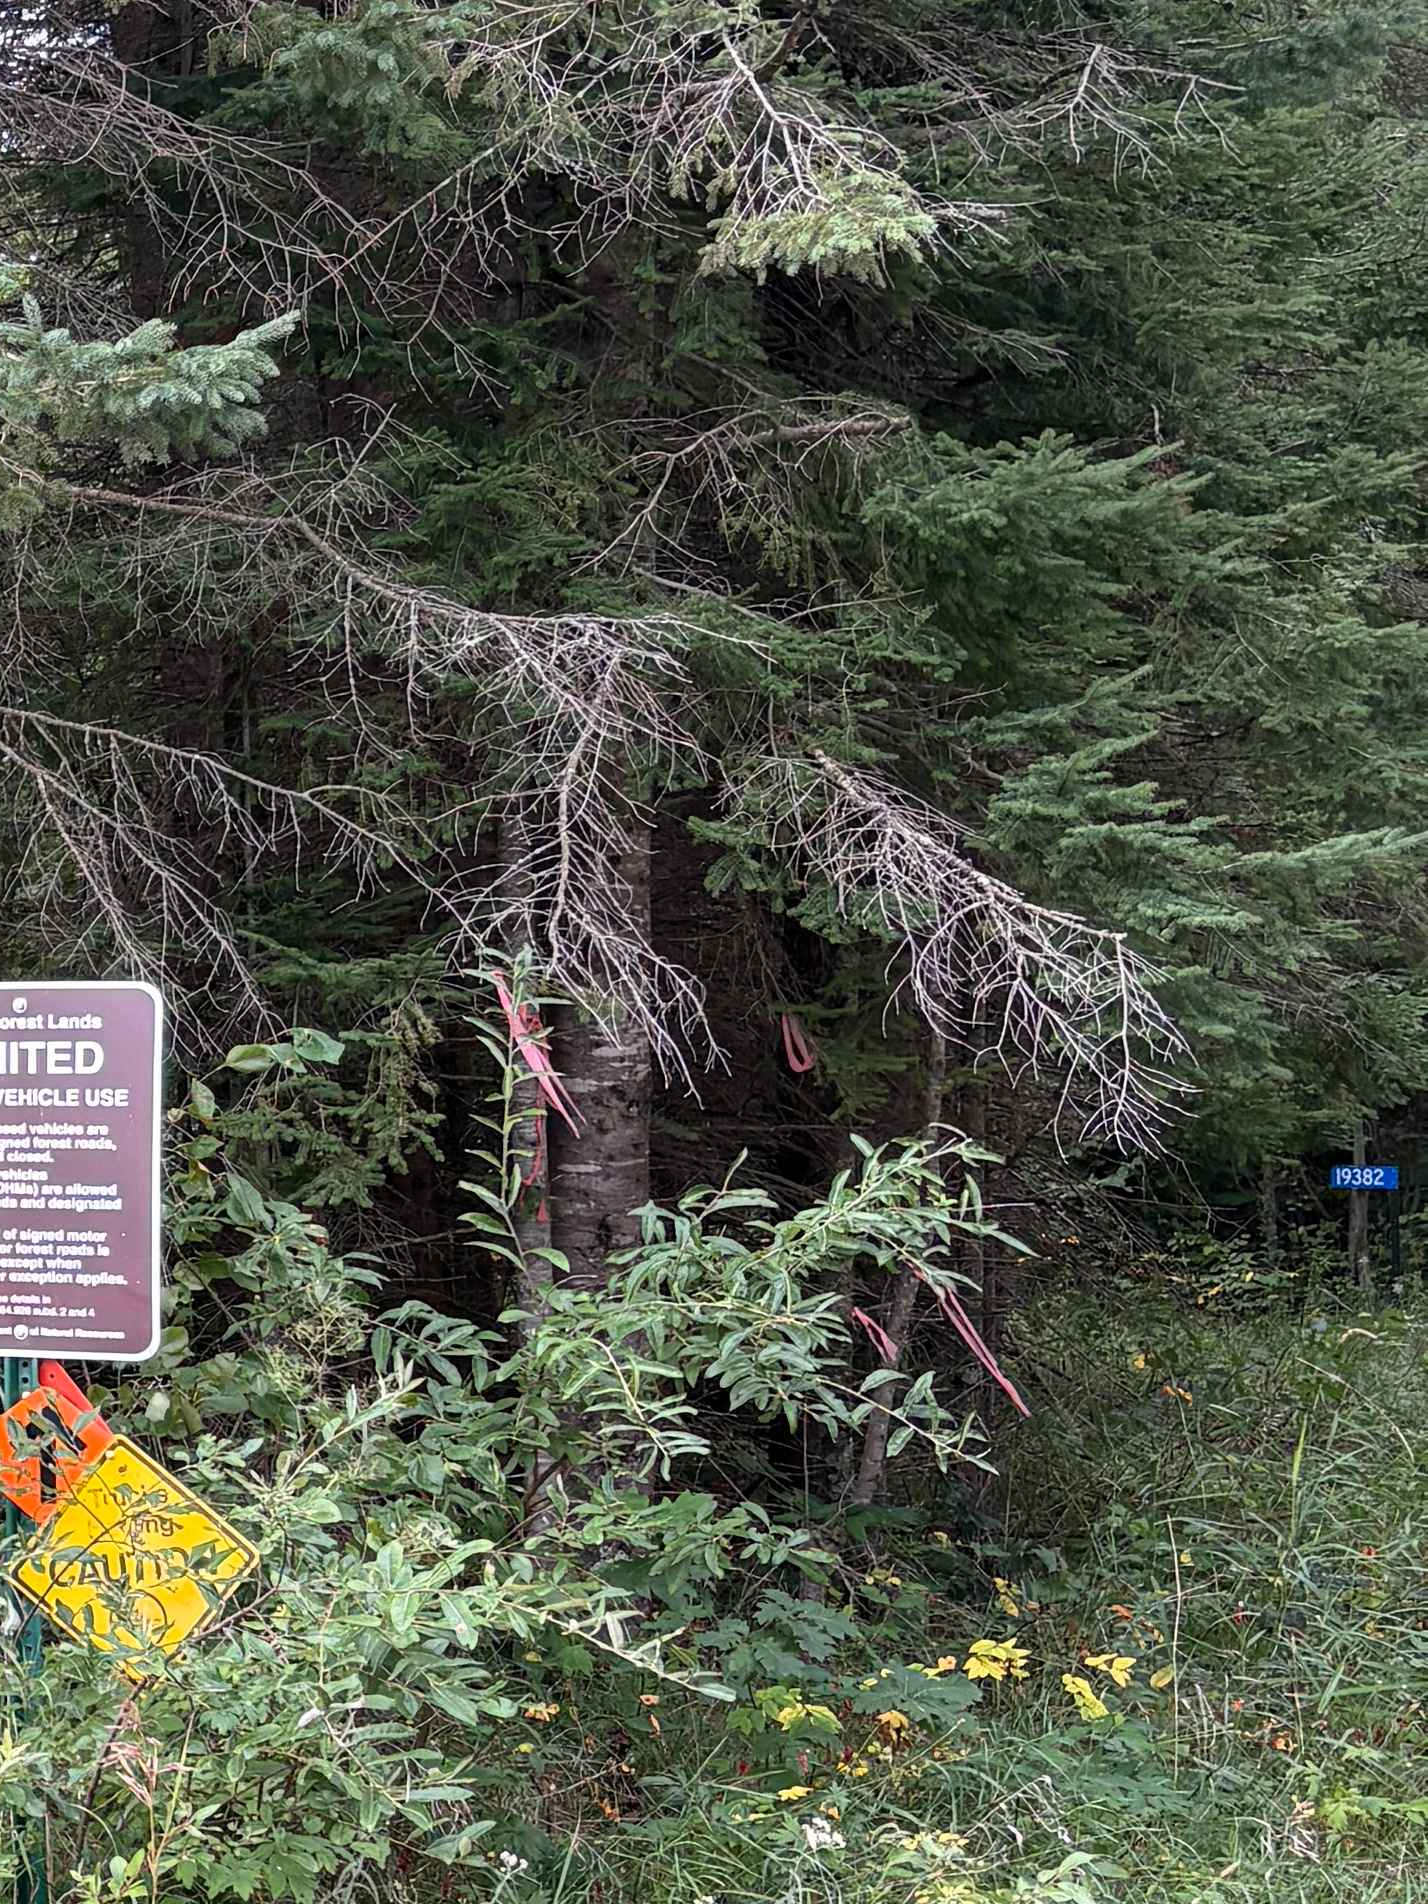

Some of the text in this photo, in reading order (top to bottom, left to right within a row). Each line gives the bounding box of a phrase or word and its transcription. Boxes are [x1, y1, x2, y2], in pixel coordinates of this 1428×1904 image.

[48, 1014, 103, 1030] Lands
[84, 1089, 128, 1107] USE
[29, 1123, 84, 1135] vehicles
[87, 1125, 108, 1135] are
[33, 1137, 72, 1149] forest
[74, 1137, 117, 1151] roads,
[7, 1151, 54, 1163] closed.
[1335, 1167, 1385, 1186] 19382
[41, 1184, 62, 1195] are
[65, 1183, 117, 1196] allowed
[20, 1197, 45, 1209] and
[48, 1198, 122, 1213] designated
[3, 1228, 18, 1240] of
[19, 1229, 64, 1243] signed
[66, 1231, 107, 1242] motor
[16, 1242, 54, 1255] forest
[56, 1244, 94, 1257] roads
[97, 1244, 110, 1256] is
[0, 1257, 44, 1270] except
[46, 1258, 82, 1270] when
[9, 1270, 73, 1285] exception
[76, 1272, 128, 1287] applies.
[10, 1294, 40, 1304] details
[68, 1307, 87, 1317] and
